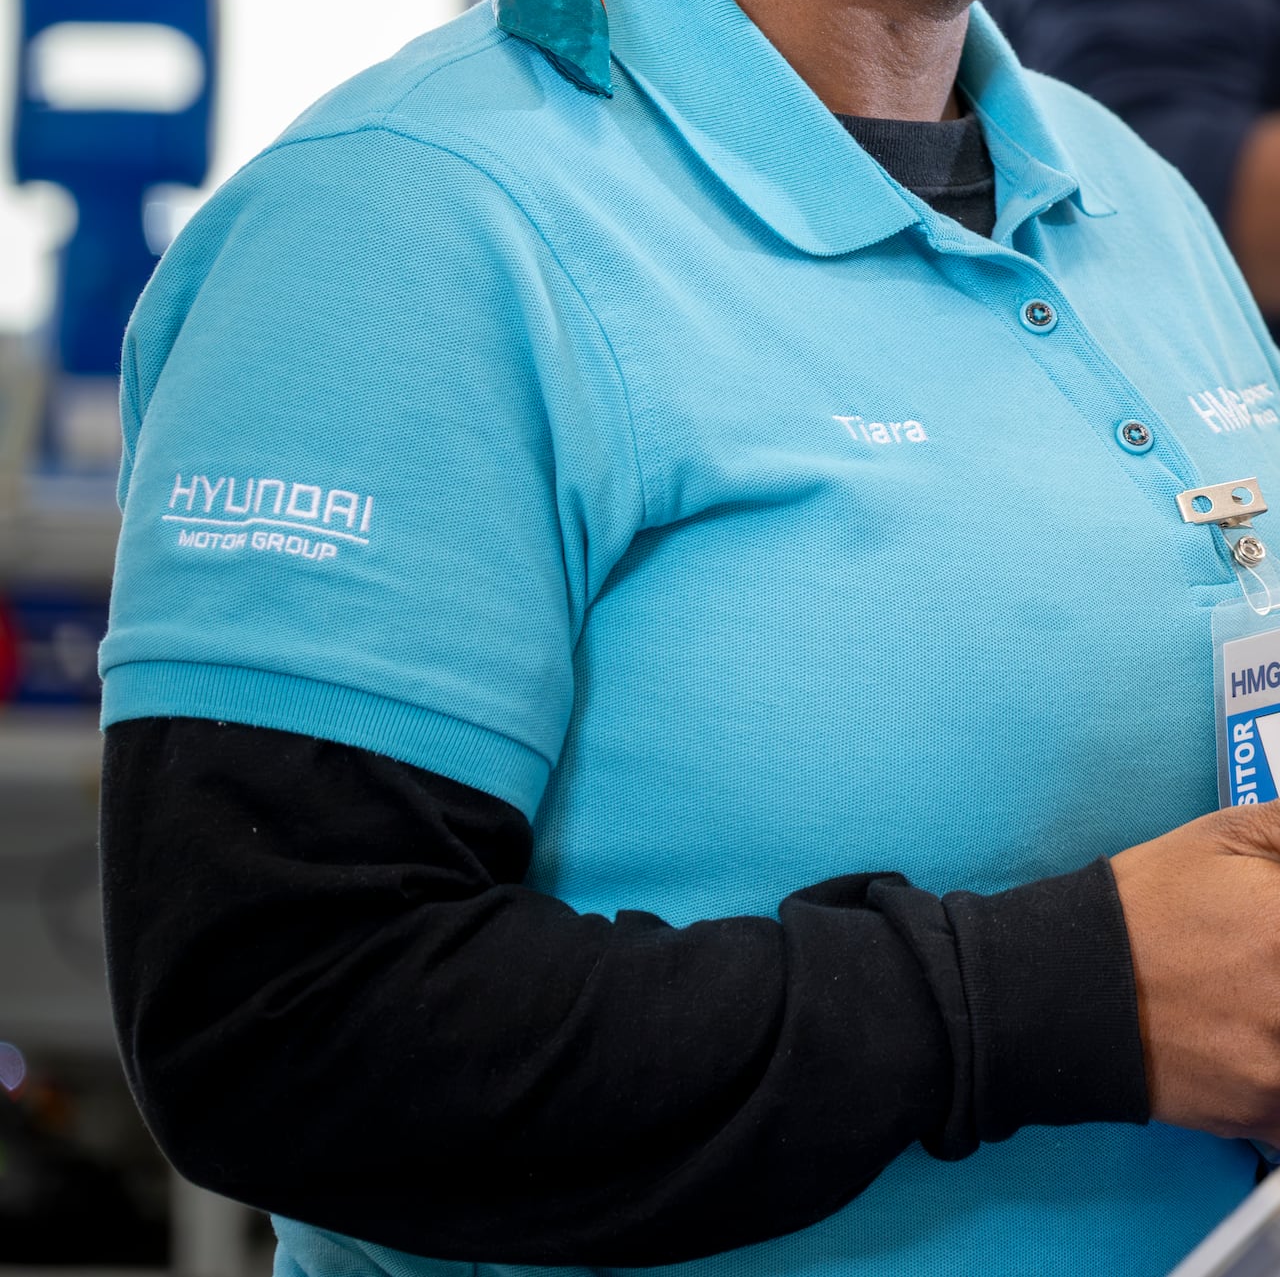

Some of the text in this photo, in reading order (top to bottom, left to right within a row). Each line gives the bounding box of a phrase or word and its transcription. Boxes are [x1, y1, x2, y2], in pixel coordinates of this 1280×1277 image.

[831, 415, 928, 444] Tiara
[168, 474, 374, 533] HYUNDAI
[178, 529, 338, 561] MOTOR GROUP
[1233, 719, 1258, 807] SITOR
